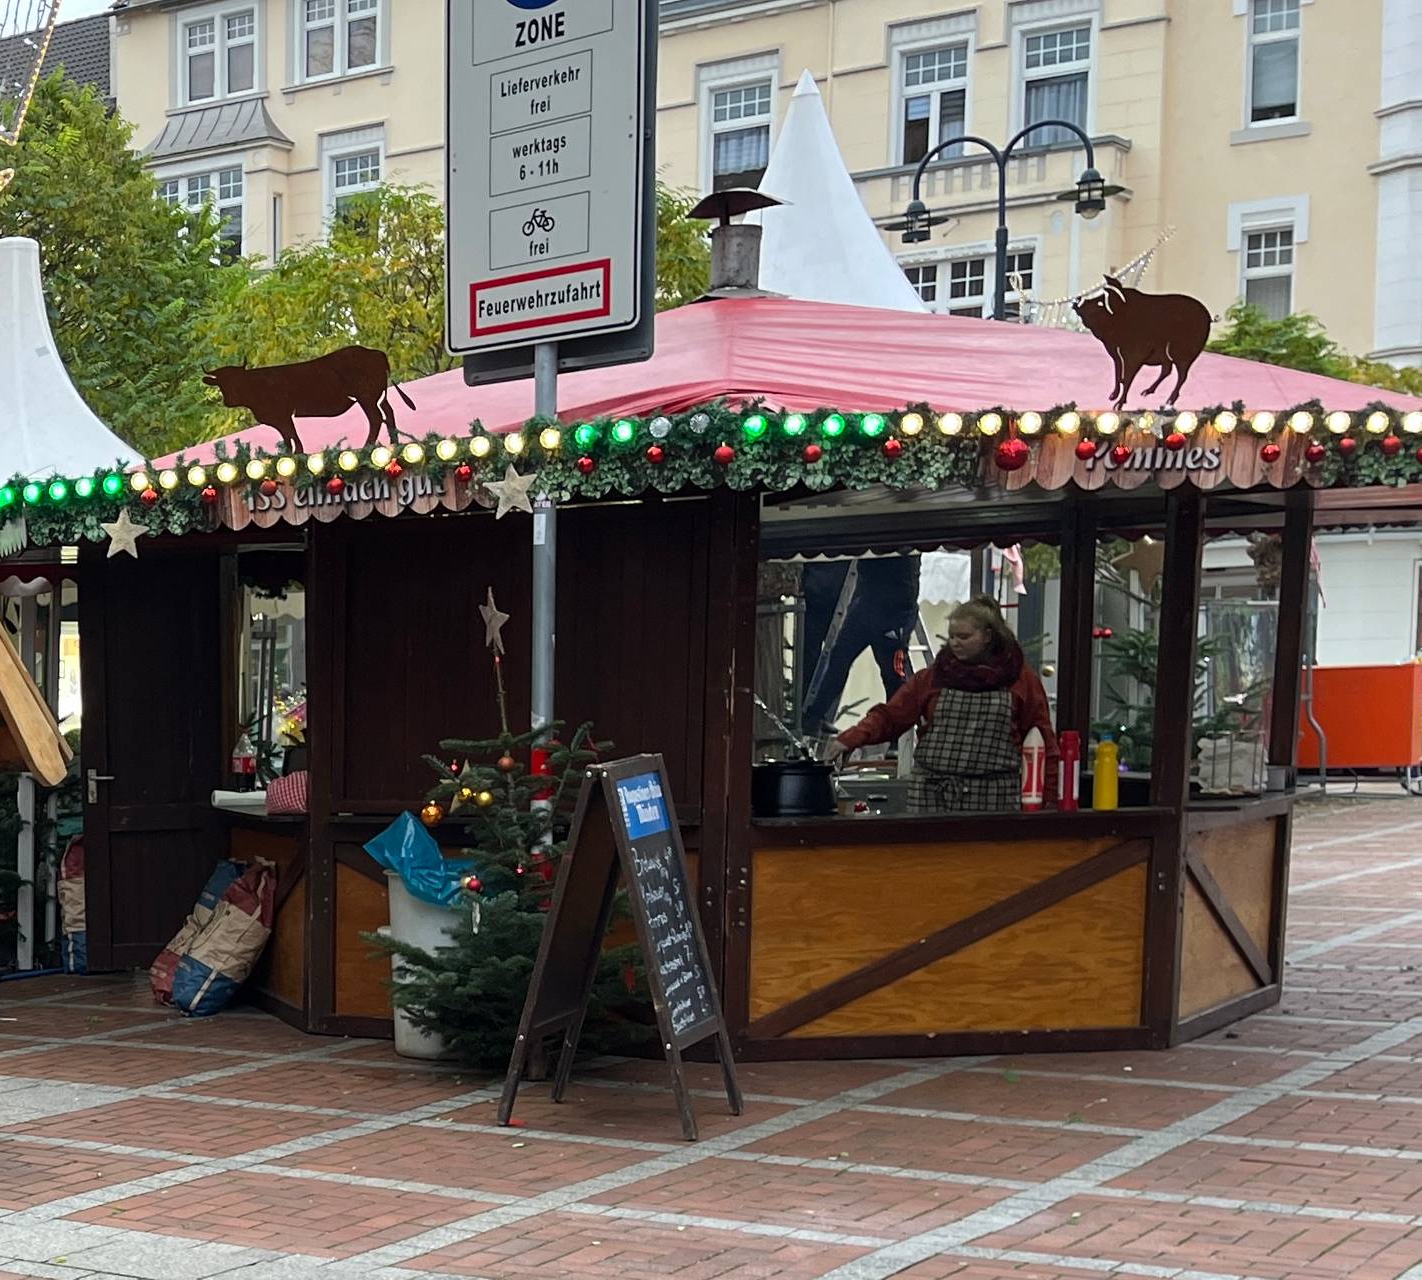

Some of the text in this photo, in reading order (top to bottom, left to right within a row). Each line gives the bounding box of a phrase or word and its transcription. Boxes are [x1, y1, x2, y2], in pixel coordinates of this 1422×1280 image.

[514, 12, 566, 48] ZONE
[500, 66, 581, 98] Lieferverkehr
[530, 96, 552, 116] frei
[512, 134, 567, 159] werktags
[519, 164, 527, 181] 6
[538, 159, 560, 177] 11h
[529, 237, 550, 257] frei
[478, 280, 602, 318] Feuerwehrzufahrt
[398, 474, 446, 506] gu
